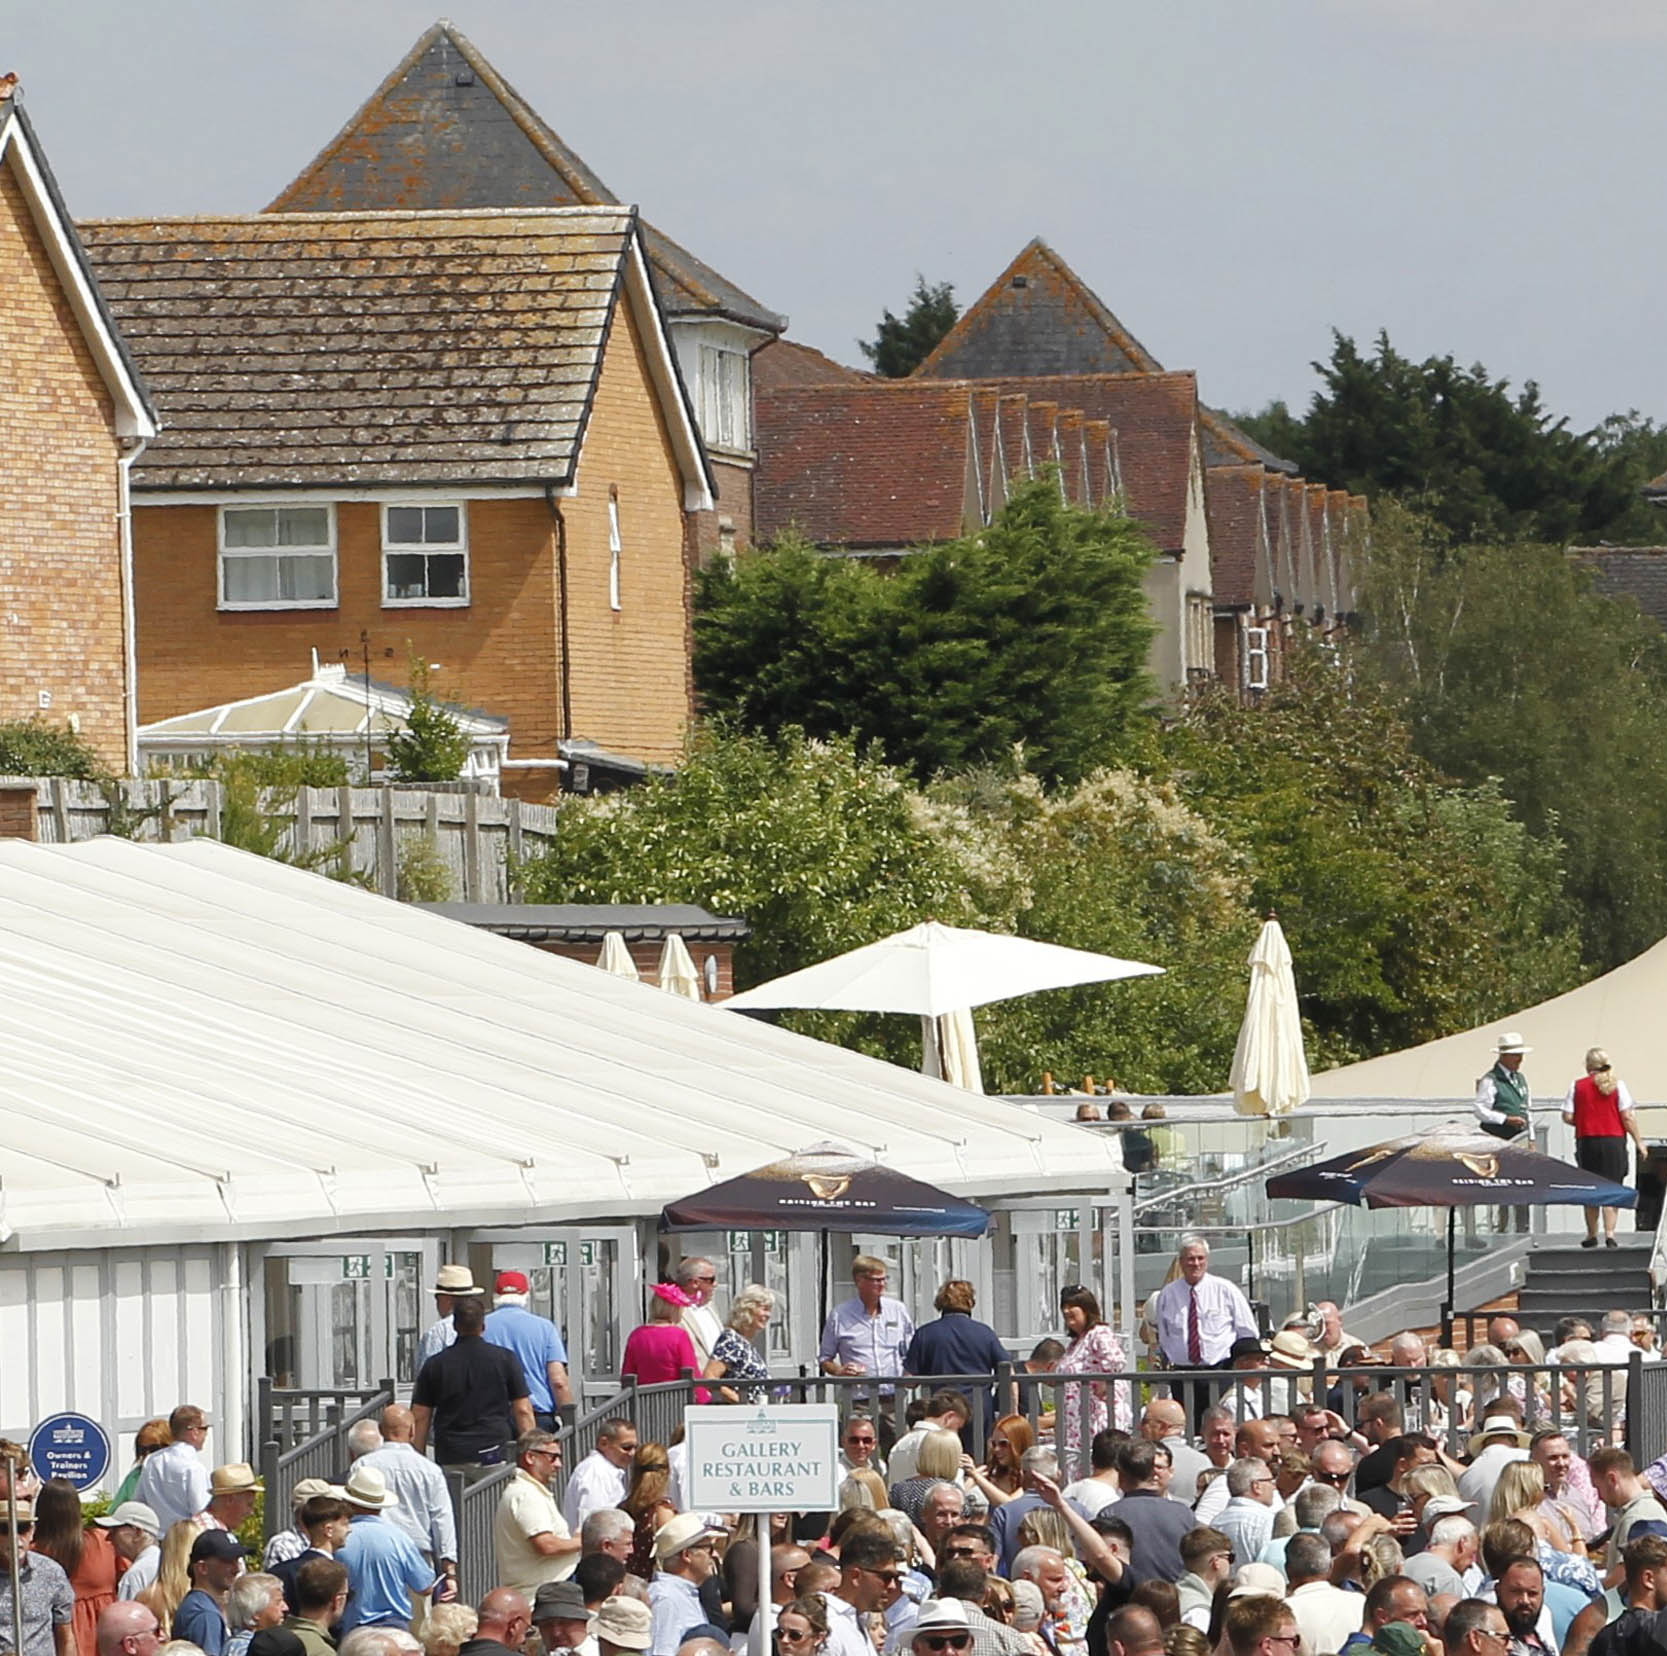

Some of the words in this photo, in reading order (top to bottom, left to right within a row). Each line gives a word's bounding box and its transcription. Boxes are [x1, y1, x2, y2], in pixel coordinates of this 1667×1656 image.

[46, 1451, 81, 1459] Owners
[721, 1442, 802, 1457] GALLERY
[51, 1460, 88, 1469] Trainers
[703, 1462, 821, 1477] RESTAURANT
[729, 1482, 741, 1496] &
[749, 1482, 794, 1496] BARS
